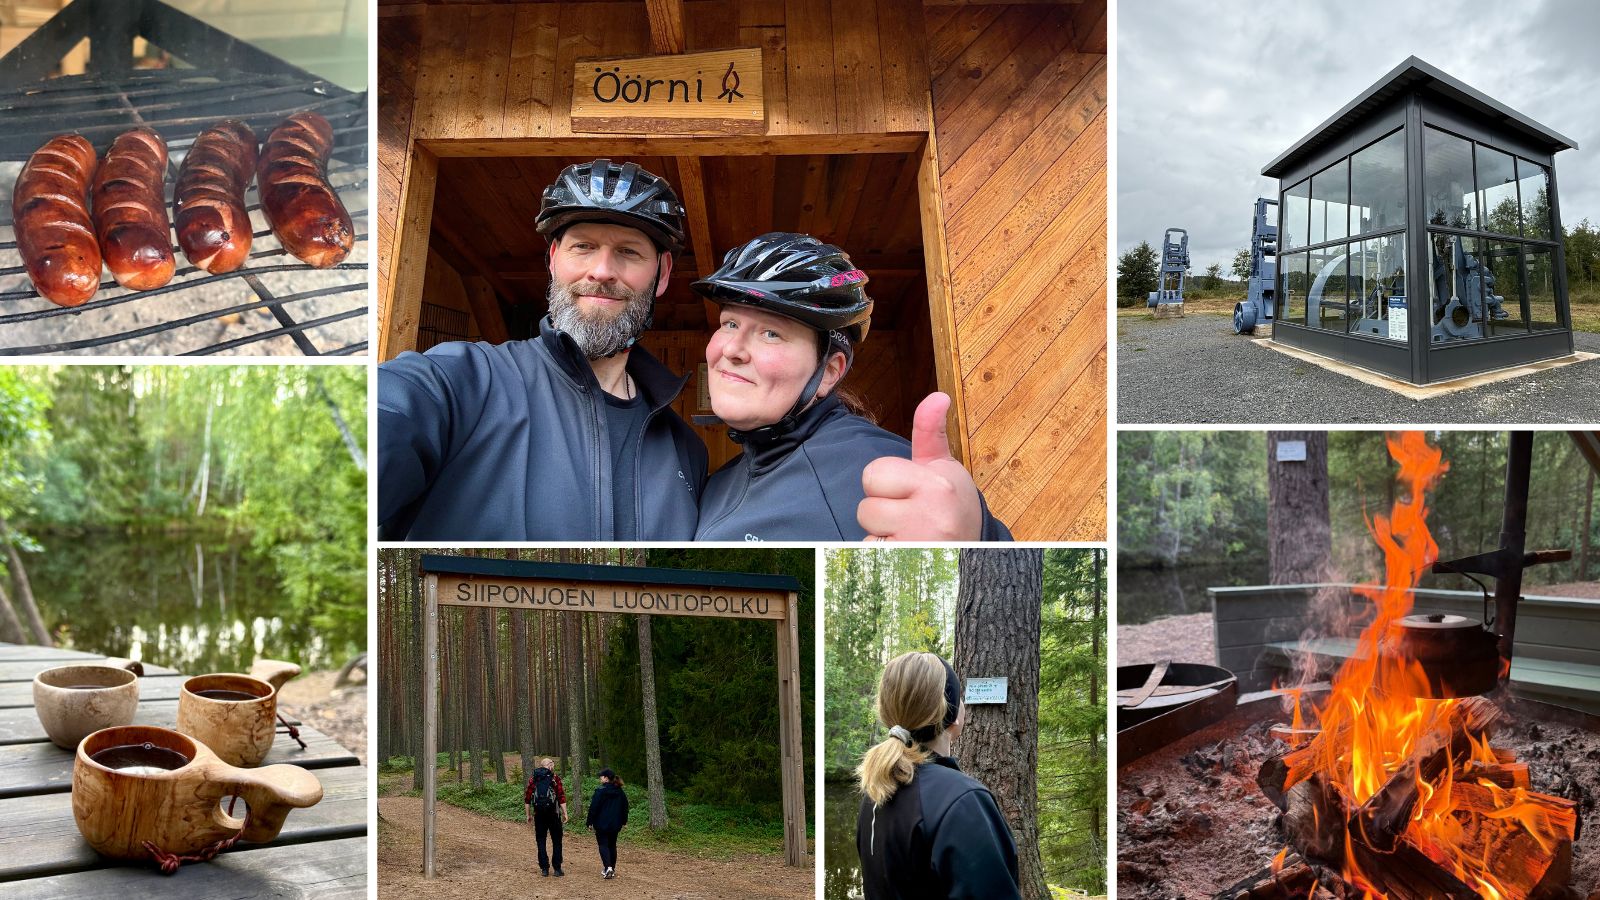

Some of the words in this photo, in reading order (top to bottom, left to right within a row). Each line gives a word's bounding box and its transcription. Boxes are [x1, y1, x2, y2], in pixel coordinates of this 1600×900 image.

[593, 67, 703, 103] Öörni
[456, 582, 596, 608] SIIPONJOEN
[612, 591, 770, 615] LUONTOPOLKU
